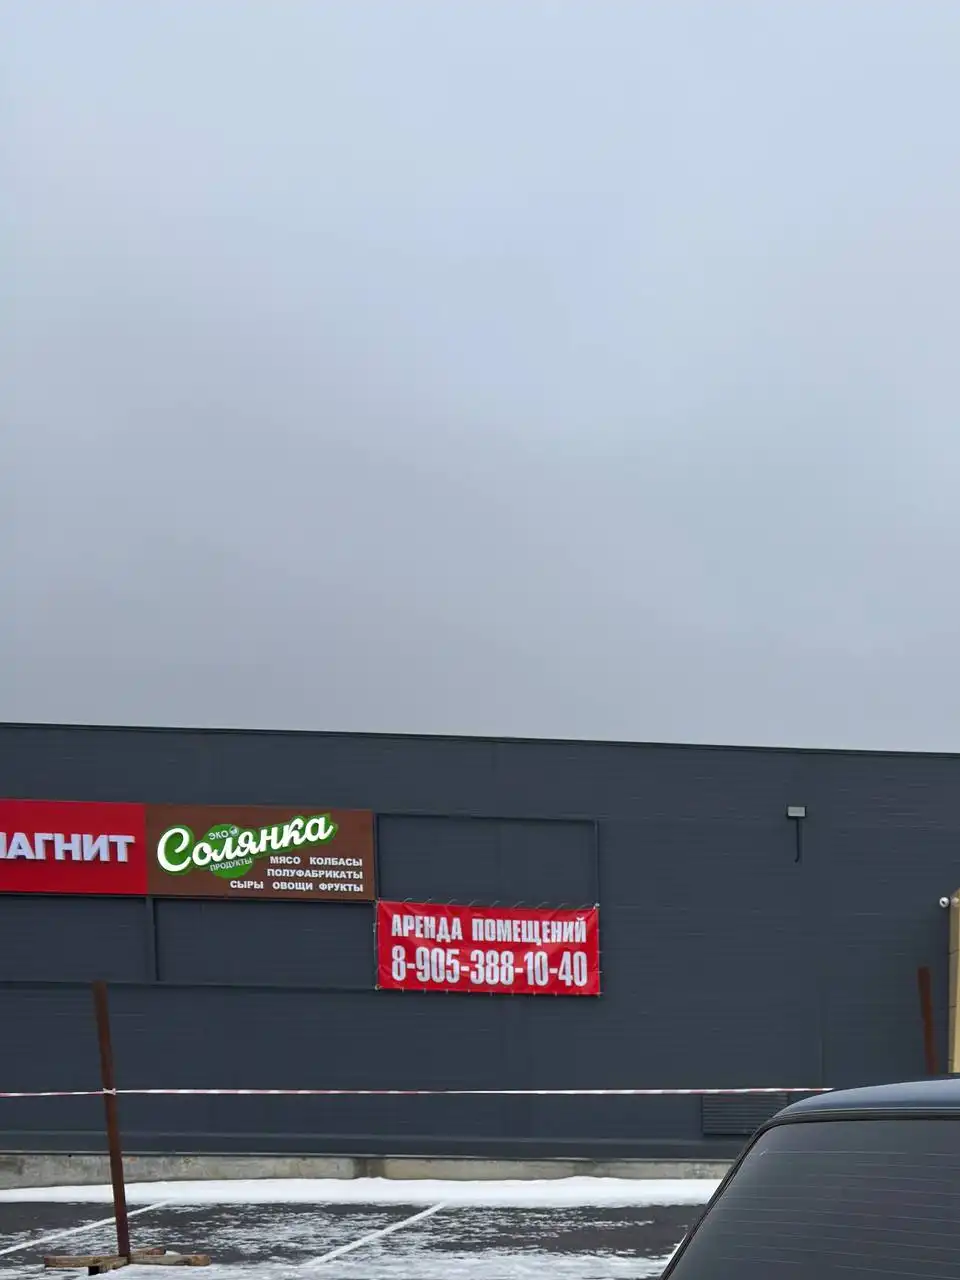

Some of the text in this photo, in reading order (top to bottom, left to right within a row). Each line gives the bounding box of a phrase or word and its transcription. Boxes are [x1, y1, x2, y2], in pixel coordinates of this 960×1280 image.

[208, 830, 229, 841] ЭКО
[0, 831, 136, 862] АГНИТ
[157, 815, 334, 872] Солянка
[209, 857, 253, 872] ПРОДУКТЫ
[269, 855, 363, 867] МЯСО КОЛБАСЫ
[266, 868, 364, 880] ПОЛУФАБРИКАТЫ
[229, 880, 364, 893] СЫРЫ ОВОЩИ ФРУКТЫ
[391, 914, 587, 946] АРЕНДА ПОМЕЩЕНИЙ
[391, 944, 588, 987] 8-905-388-10-40
